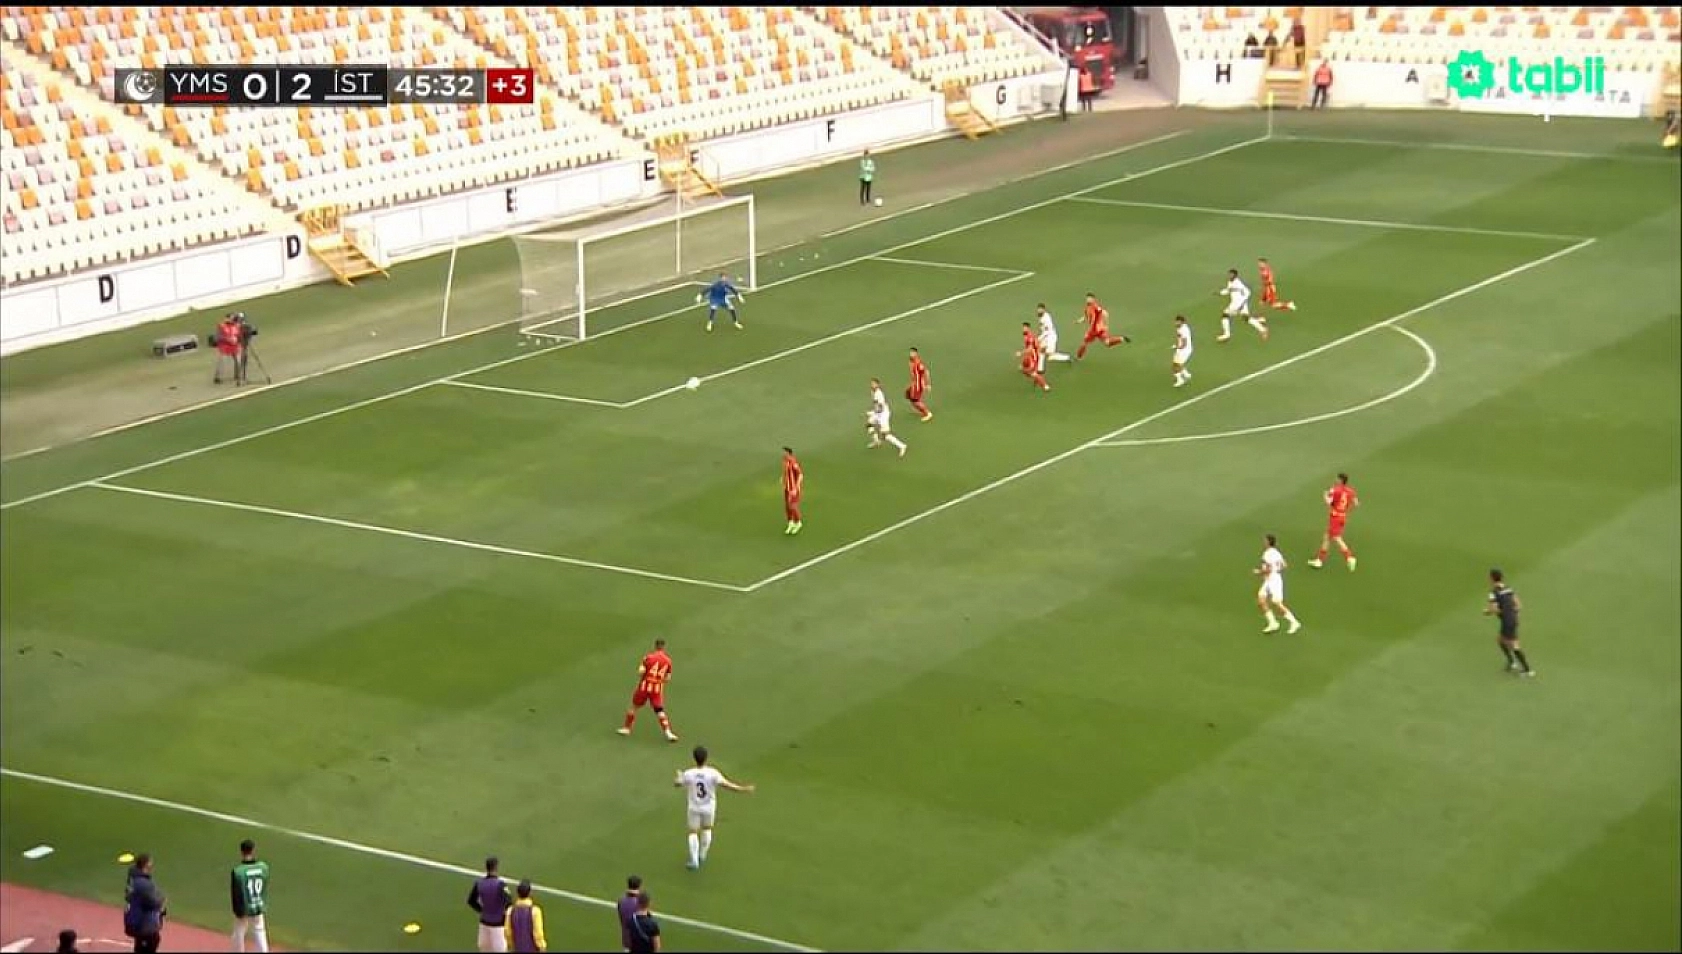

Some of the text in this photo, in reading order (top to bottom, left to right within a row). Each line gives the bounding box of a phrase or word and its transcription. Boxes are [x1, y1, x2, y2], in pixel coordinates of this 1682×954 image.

[1216, 64, 1231, 83] H
[1405, 68, 1420, 83] A
[996, 85, 1007, 104] G
[827, 120, 836, 143] F
[643, 159, 656, 182] E
[506, 187, 518, 213] E
[286, 234, 301, 260] D
[98, 273, 115, 304] D
[649, 660, 668, 680] 44
[696, 782, 707, 799] 3
